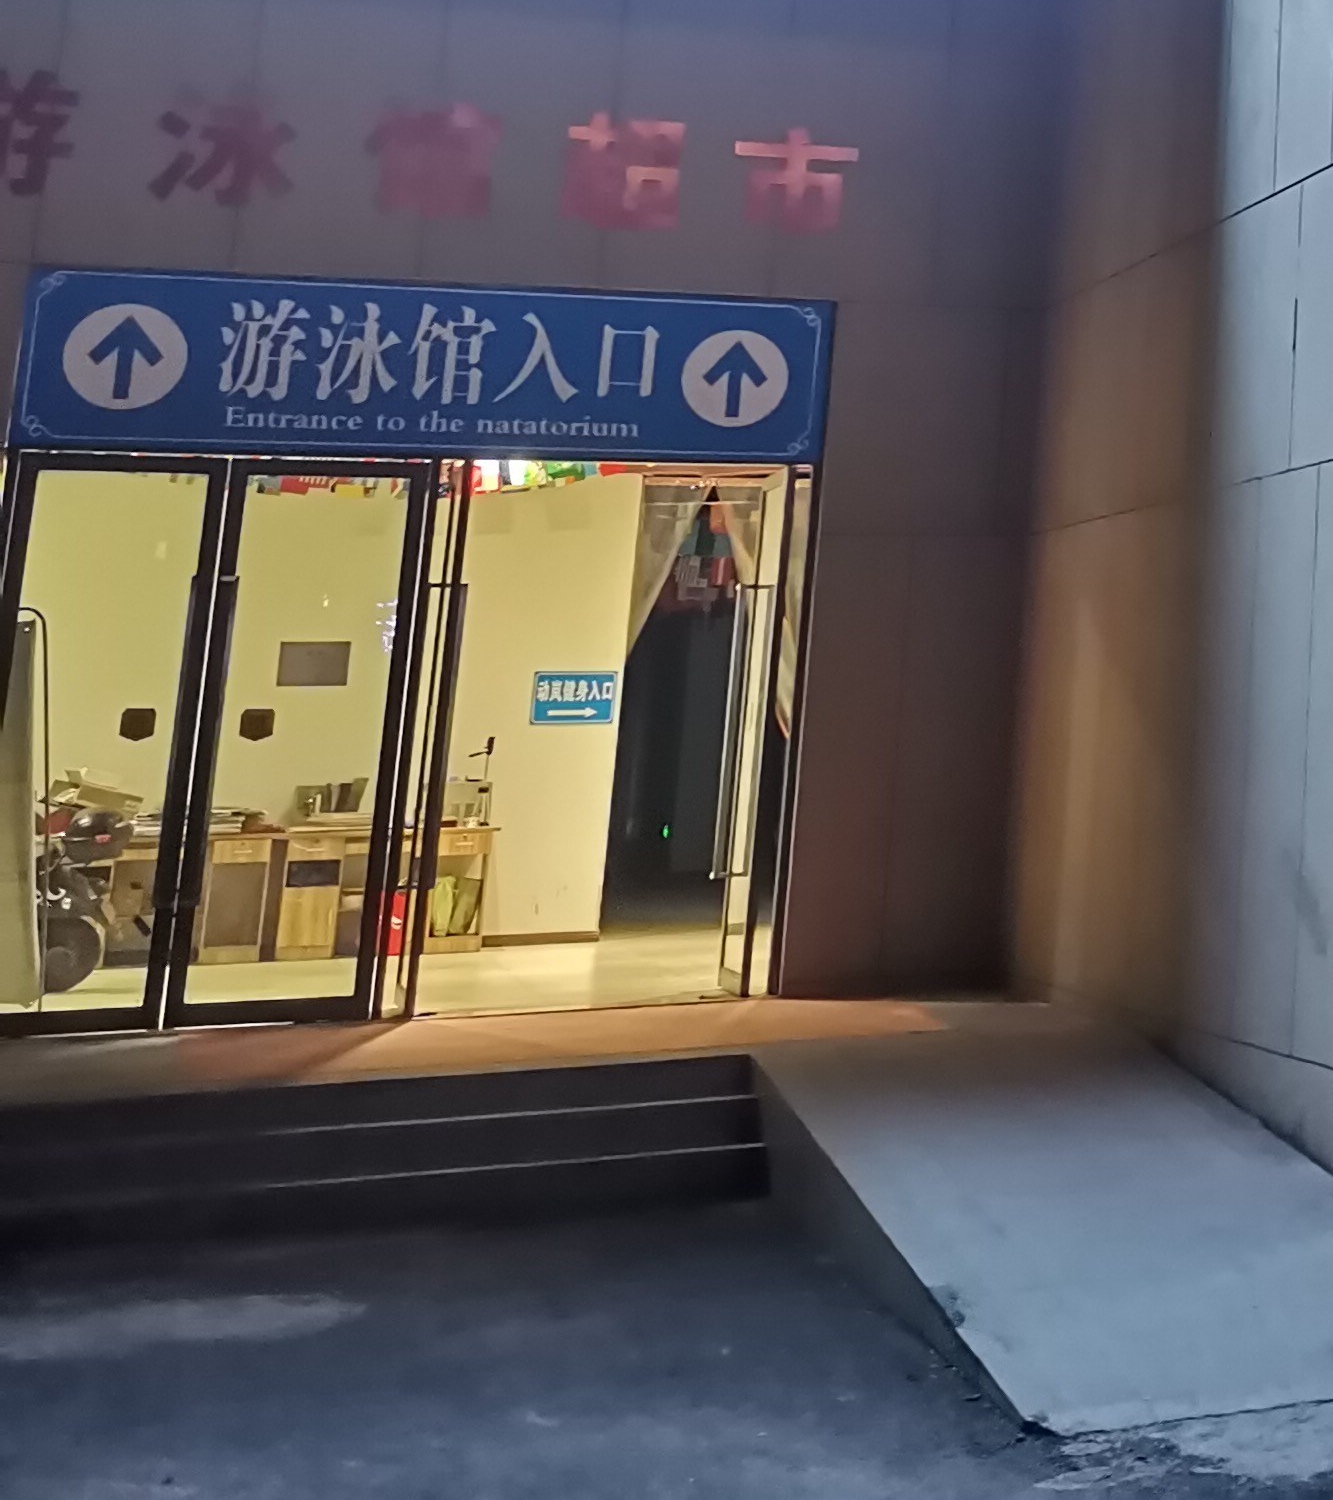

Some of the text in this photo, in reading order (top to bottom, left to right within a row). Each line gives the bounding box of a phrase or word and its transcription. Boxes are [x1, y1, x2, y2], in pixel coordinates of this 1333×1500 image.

[218, 299, 661, 405] 游泳馆入口
[224, 406, 640, 439] Entrance to the natatorium
